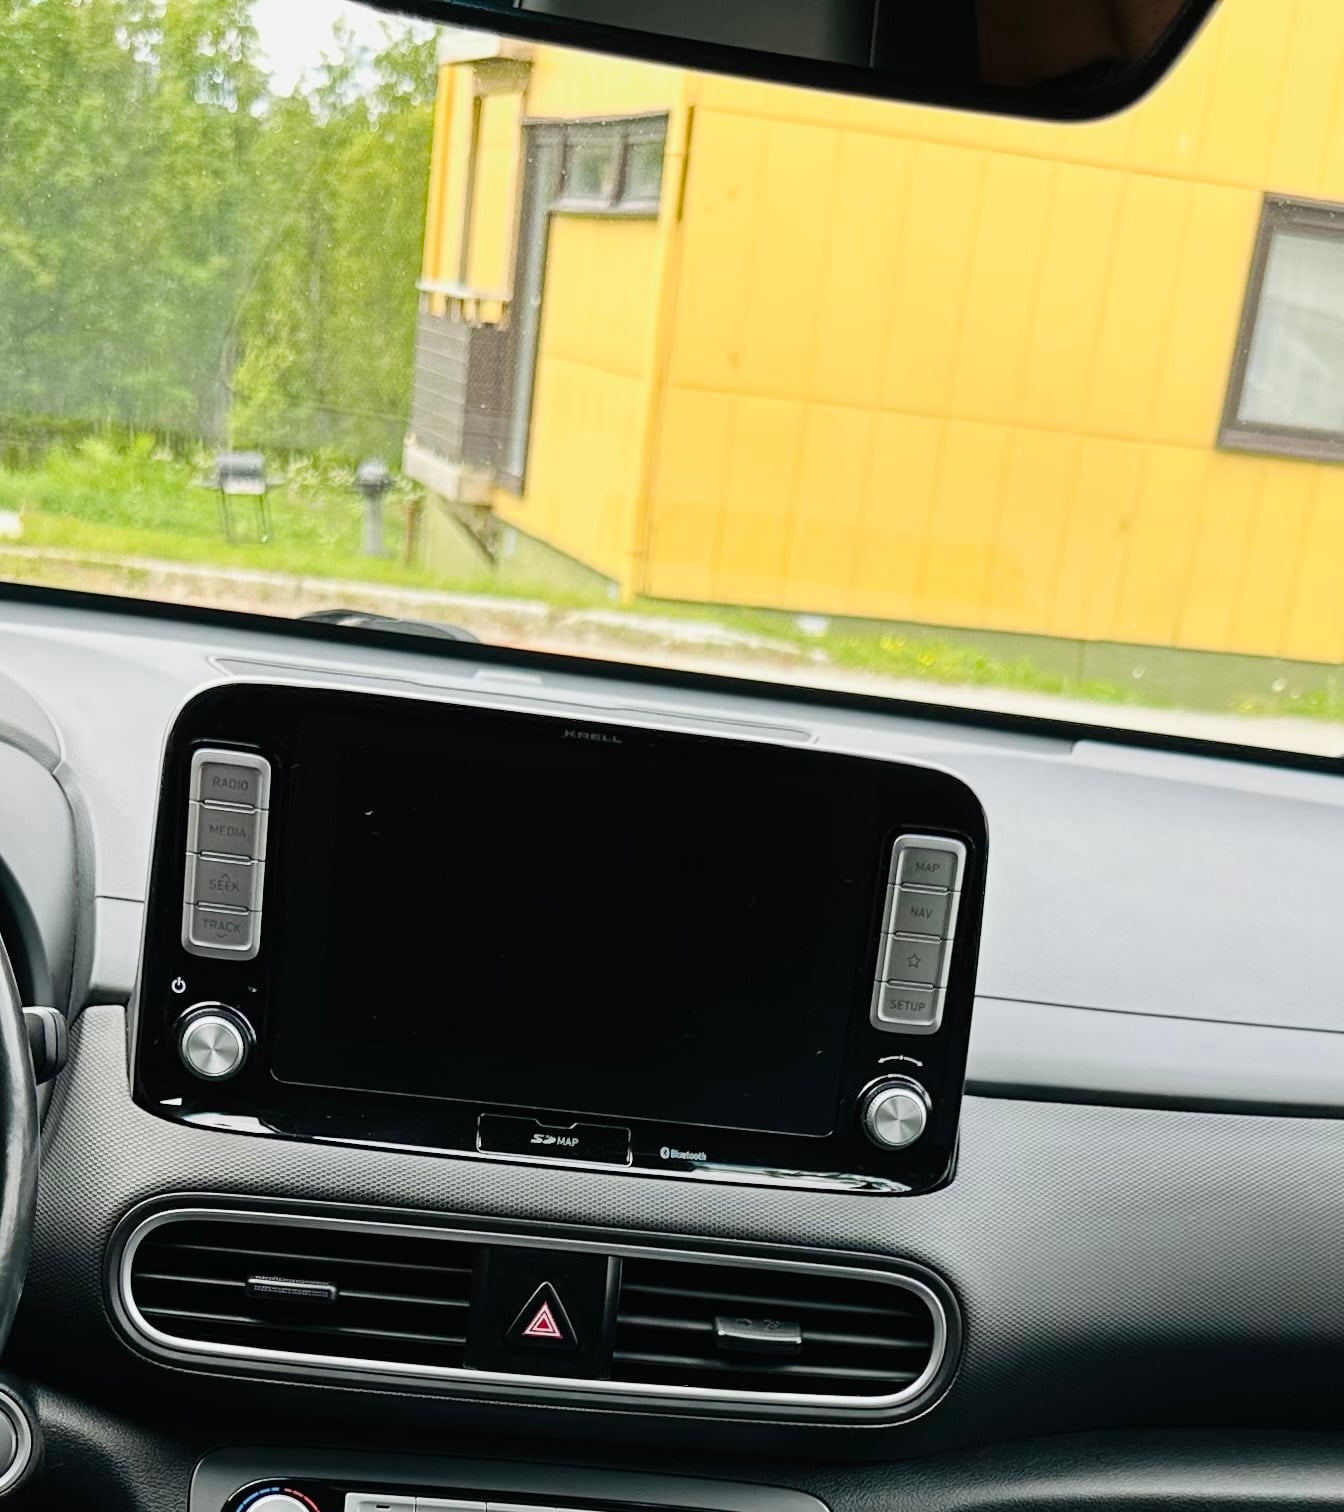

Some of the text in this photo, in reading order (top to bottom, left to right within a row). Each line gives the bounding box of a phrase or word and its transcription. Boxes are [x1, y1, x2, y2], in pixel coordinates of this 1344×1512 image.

[561, 730, 624, 744] KRELL
[212, 775, 249, 791] RADIO
[209, 825, 247, 838] MEDIA
[915, 862, 940, 873] MAP
[209, 879, 240, 892] SEEK
[910, 907, 933, 919] NAV
[202, 919, 241, 934] TRACK
[889, 1000, 926, 1012] SETUP
[556, 1136, 579, 1147] MAP
[670, 1149, 707, 1161] Bluetooth
